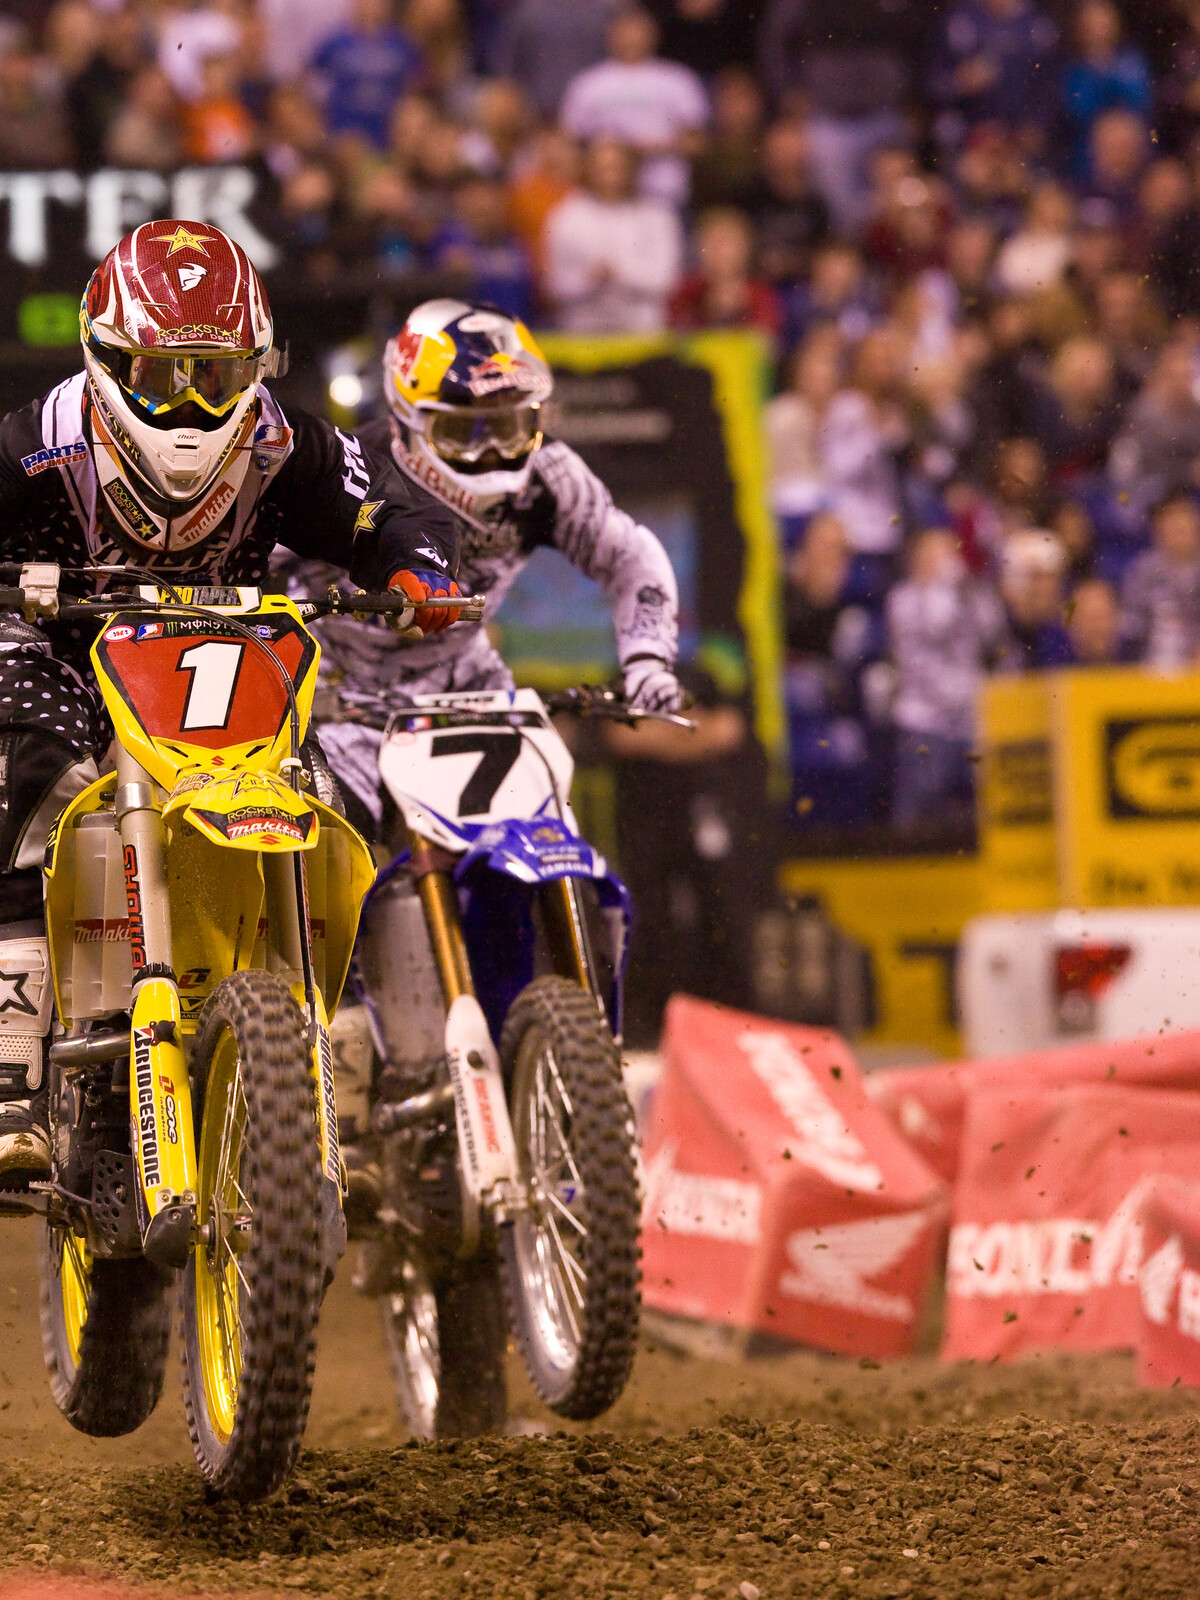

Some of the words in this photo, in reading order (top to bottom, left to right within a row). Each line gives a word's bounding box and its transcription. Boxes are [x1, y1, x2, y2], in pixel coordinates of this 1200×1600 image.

[22, 441, 87, 470] PARTS
[26, 452, 88, 477] UNLIMITED
[110, 481, 145, 521] ROCKSTAR
[183, 486, 232, 543] makita
[180, 619, 246, 630] MONST
[176, 640, 247, 732] 1
[431, 733, 522, 816] 7
[227, 821, 305, 839] makita
[133, 1027, 161, 1188] BRIDGESTONE
